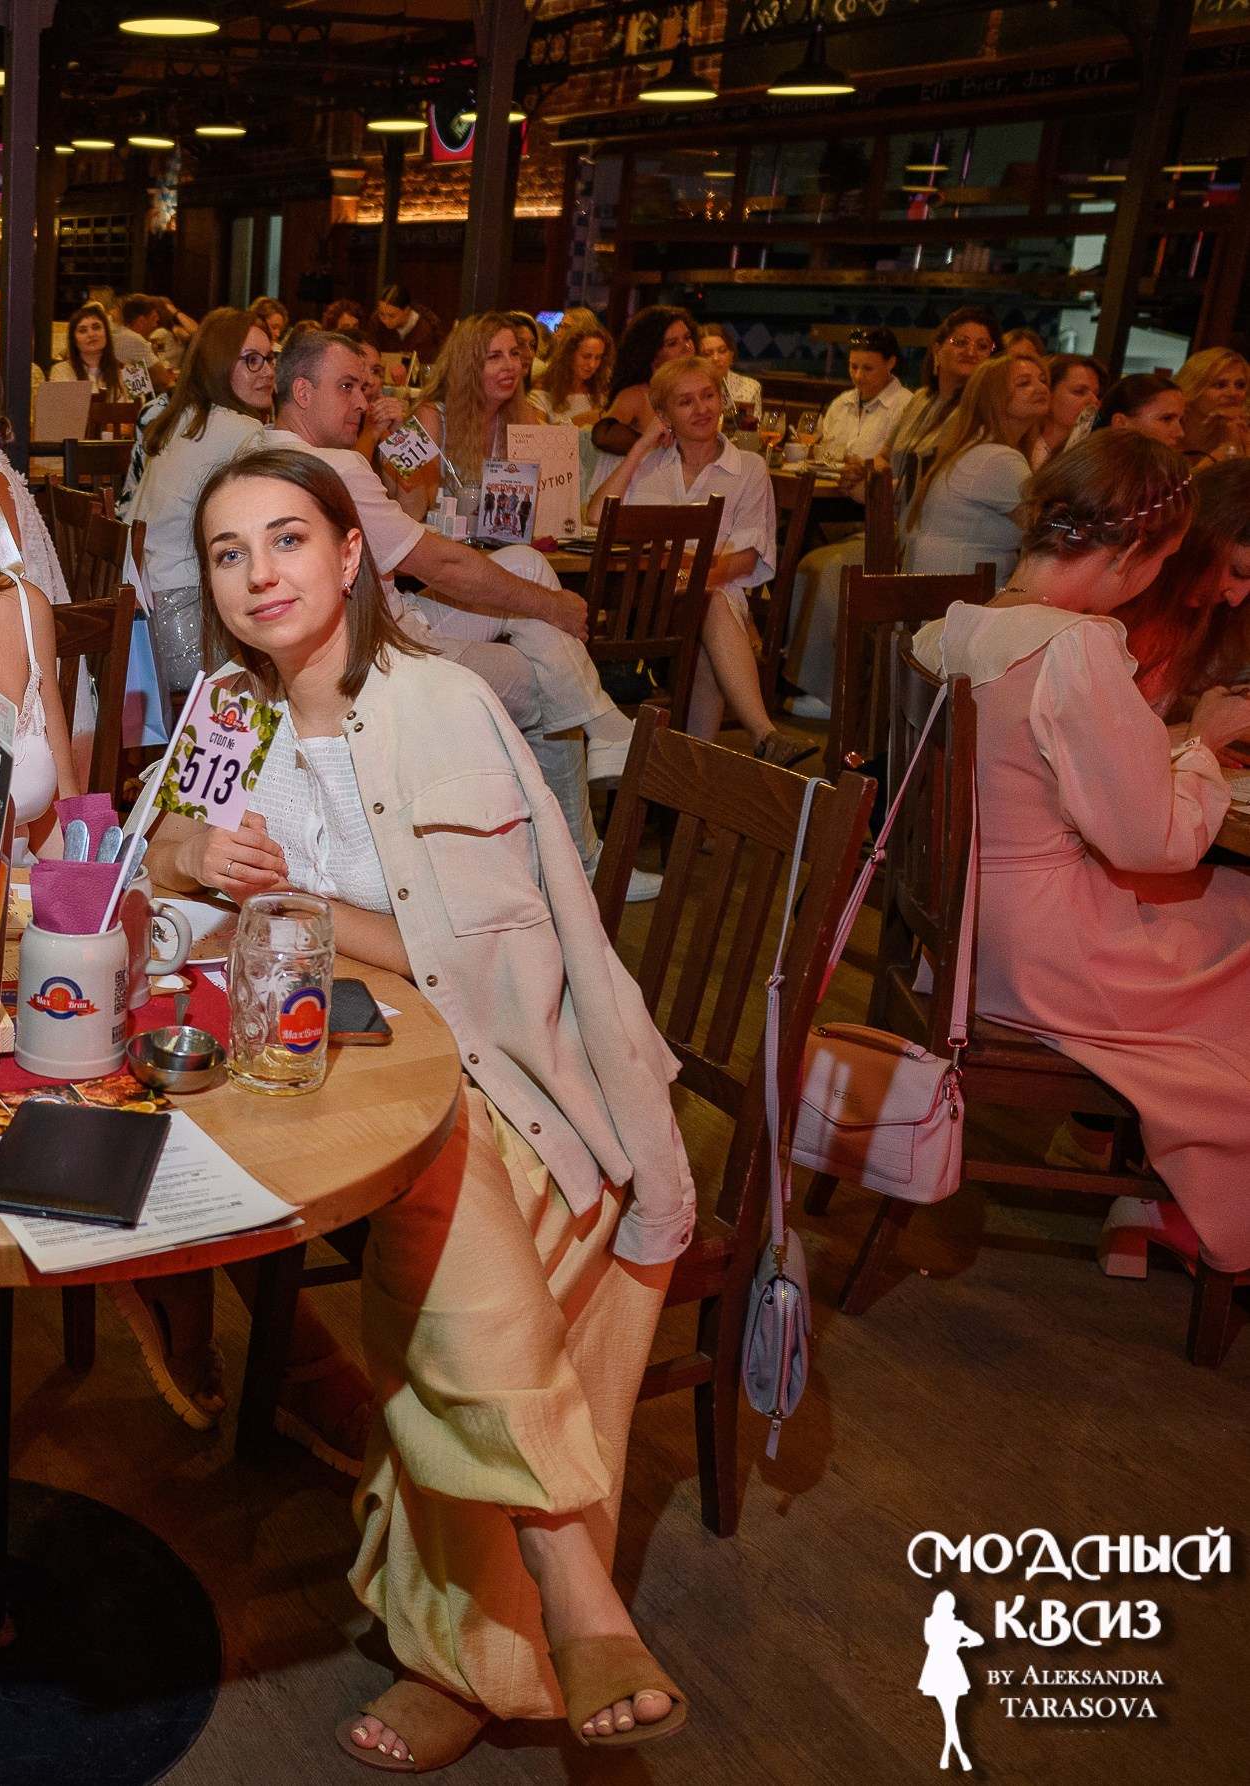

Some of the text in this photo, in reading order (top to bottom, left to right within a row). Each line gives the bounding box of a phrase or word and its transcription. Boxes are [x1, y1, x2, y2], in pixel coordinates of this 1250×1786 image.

[399, 441, 428, 468] 511
[209, 732, 227, 748] СТОЛ
[179, 746, 241, 805] 513
